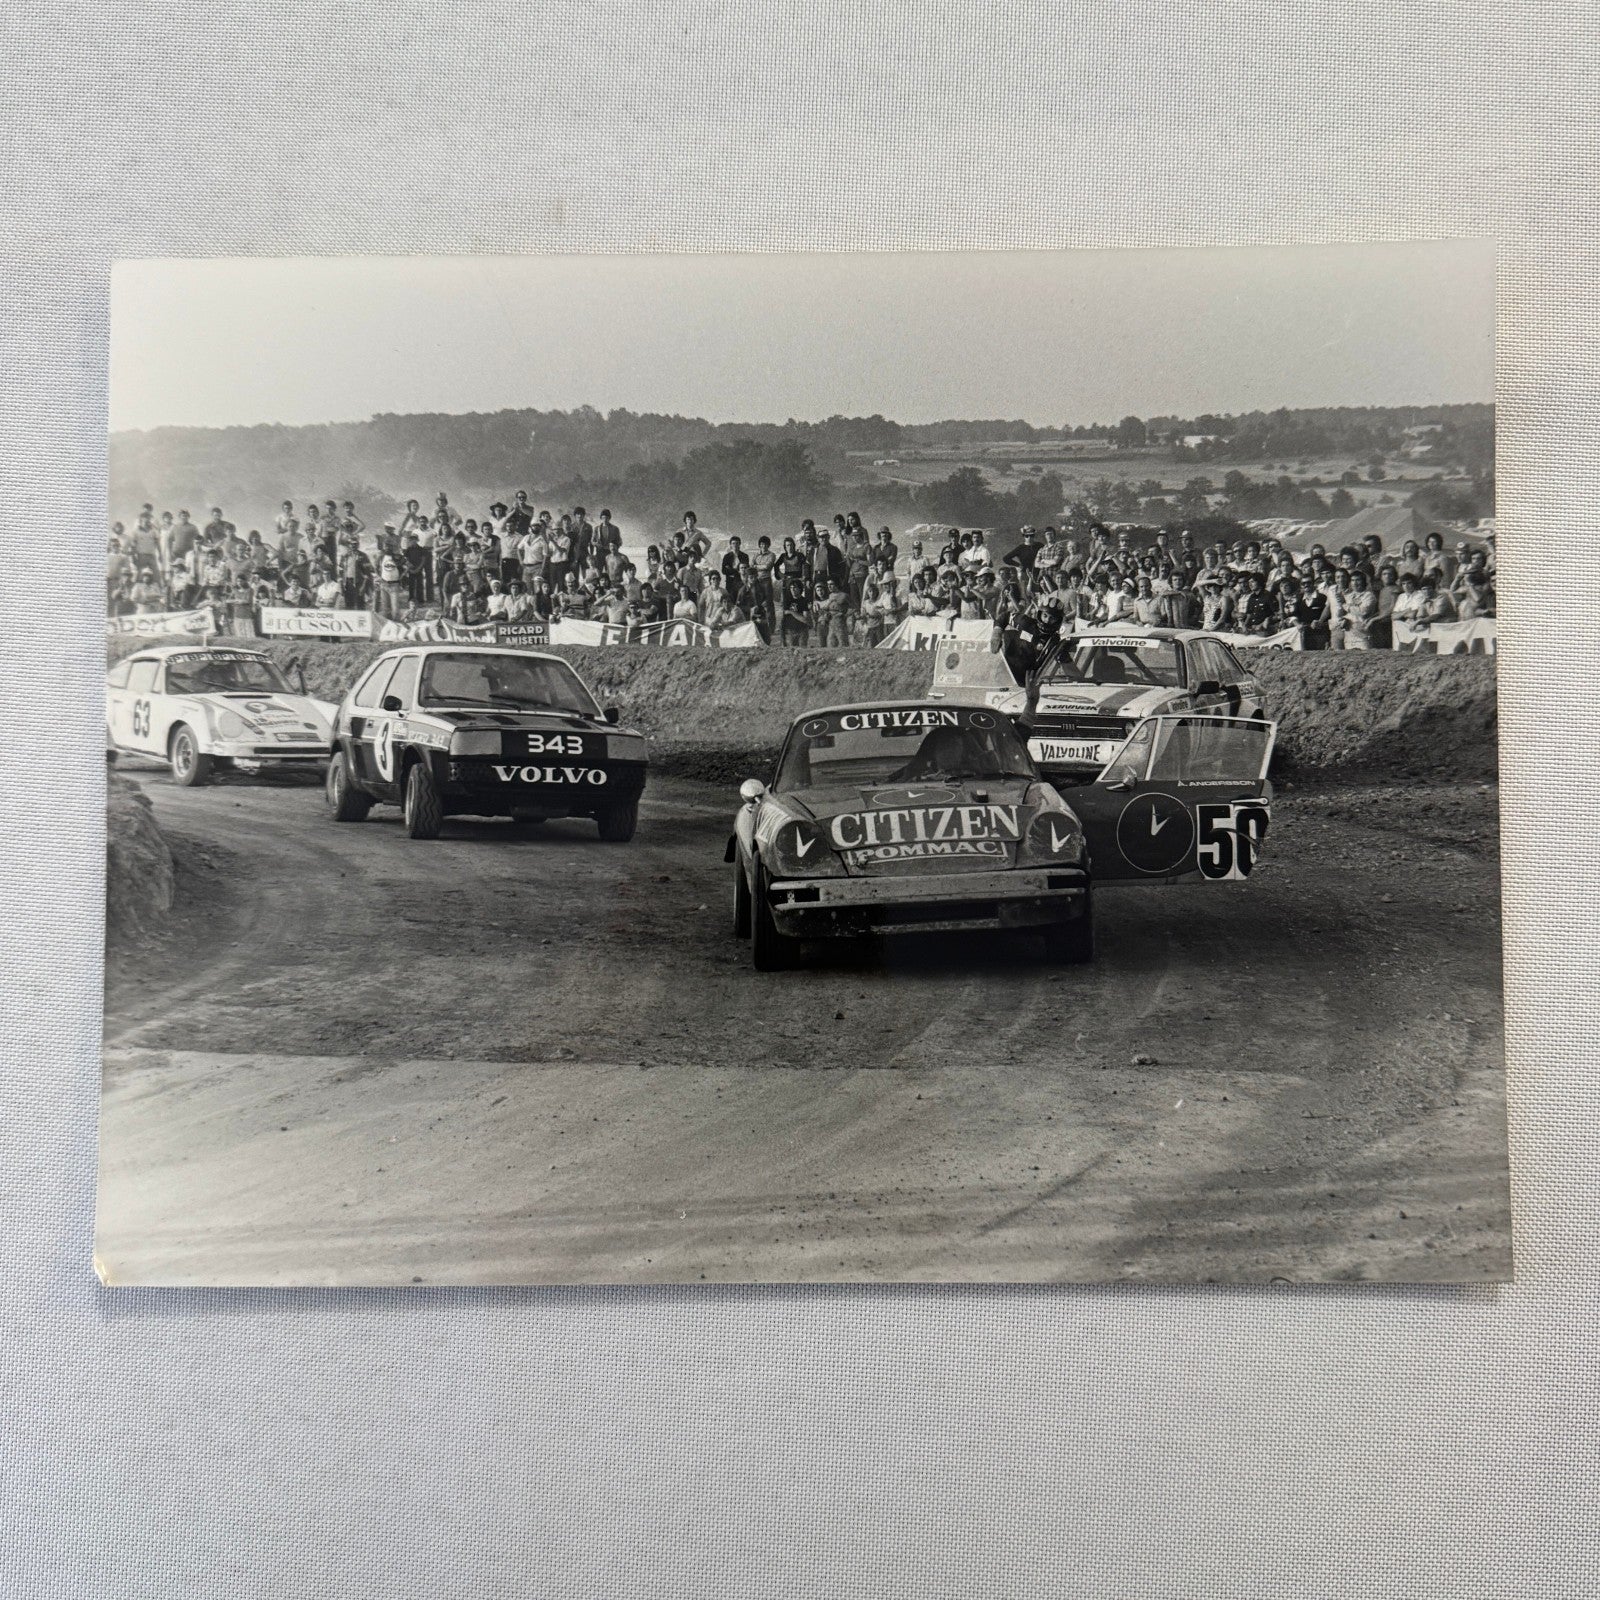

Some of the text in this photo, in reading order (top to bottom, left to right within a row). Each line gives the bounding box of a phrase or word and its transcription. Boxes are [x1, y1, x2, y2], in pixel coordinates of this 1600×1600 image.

[276, 619, 354, 633] ECUSSON
[500, 625, 544, 636] RICARD
[506, 635, 549, 645] ANISETTE
[1092, 638, 1147, 647] Valvoline
[134, 699, 150, 738] 63
[840, 710, 959, 731] CITIZEN
[380, 721, 390, 771] 3
[528, 734, 583, 755] 343
[1040, 742, 1100, 762] VALVOLINE
[491, 765, 608, 785] VOLVO
[831, 806, 1019, 847] CITIZEN
[856, 841, 999, 862] POMMAC
